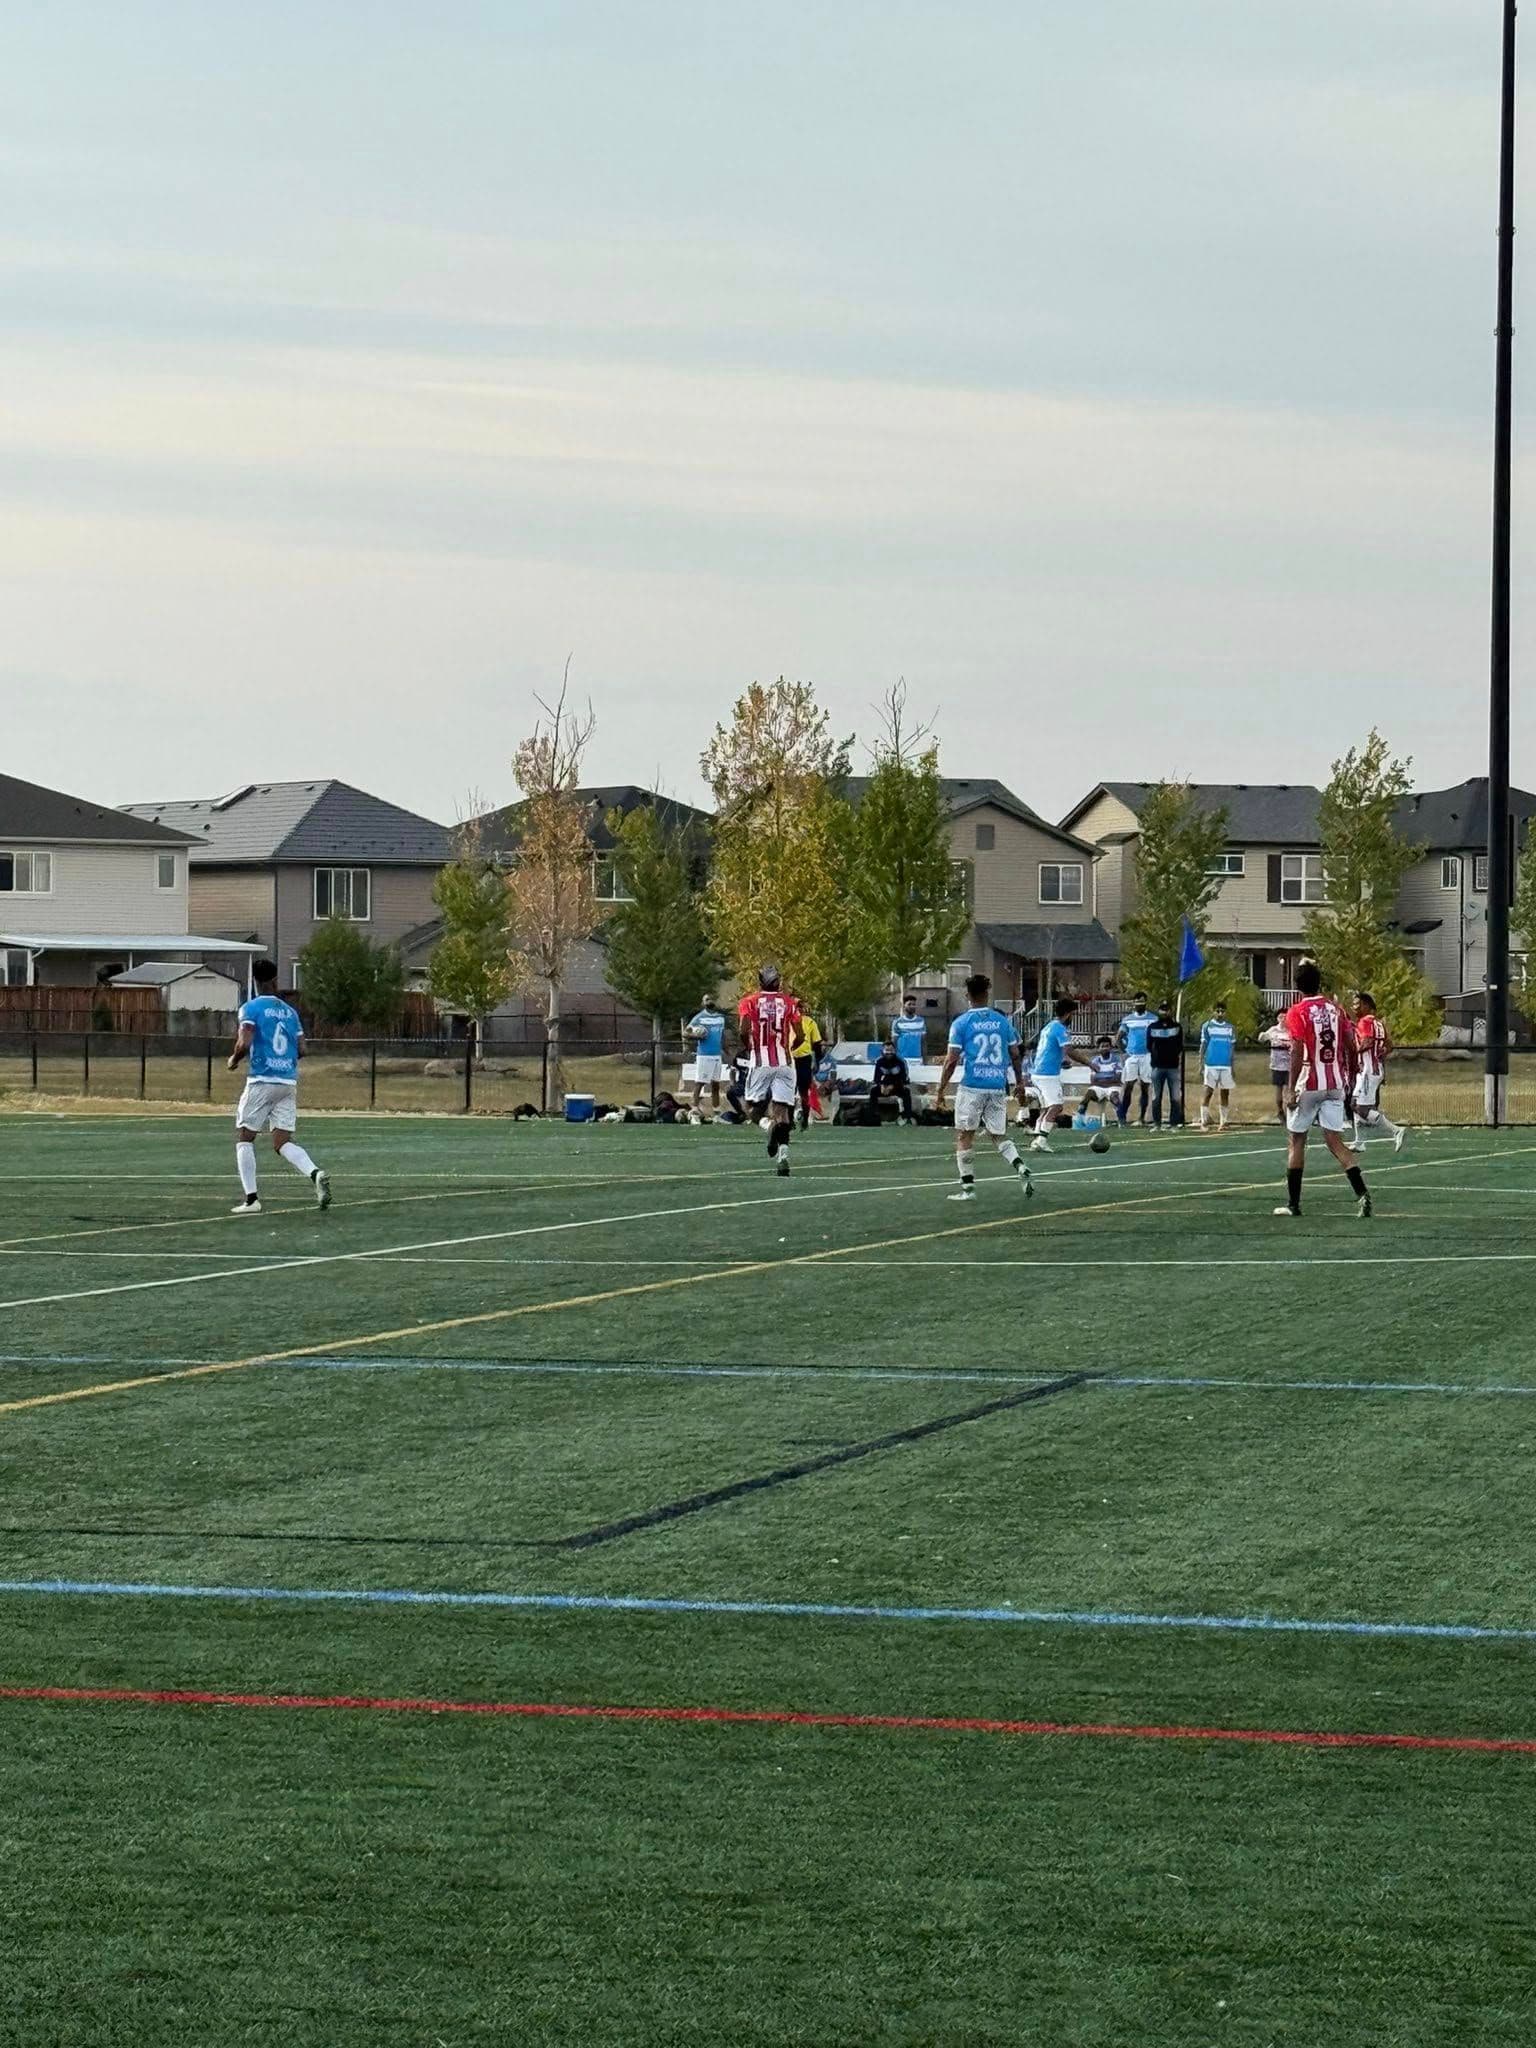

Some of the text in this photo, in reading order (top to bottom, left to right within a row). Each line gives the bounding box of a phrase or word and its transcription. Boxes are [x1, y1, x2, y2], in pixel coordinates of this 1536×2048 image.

[272, 1020, 289, 1056] 6
[973, 1032, 1003, 1066] 23
[1319, 1029, 1336, 1064] 8
